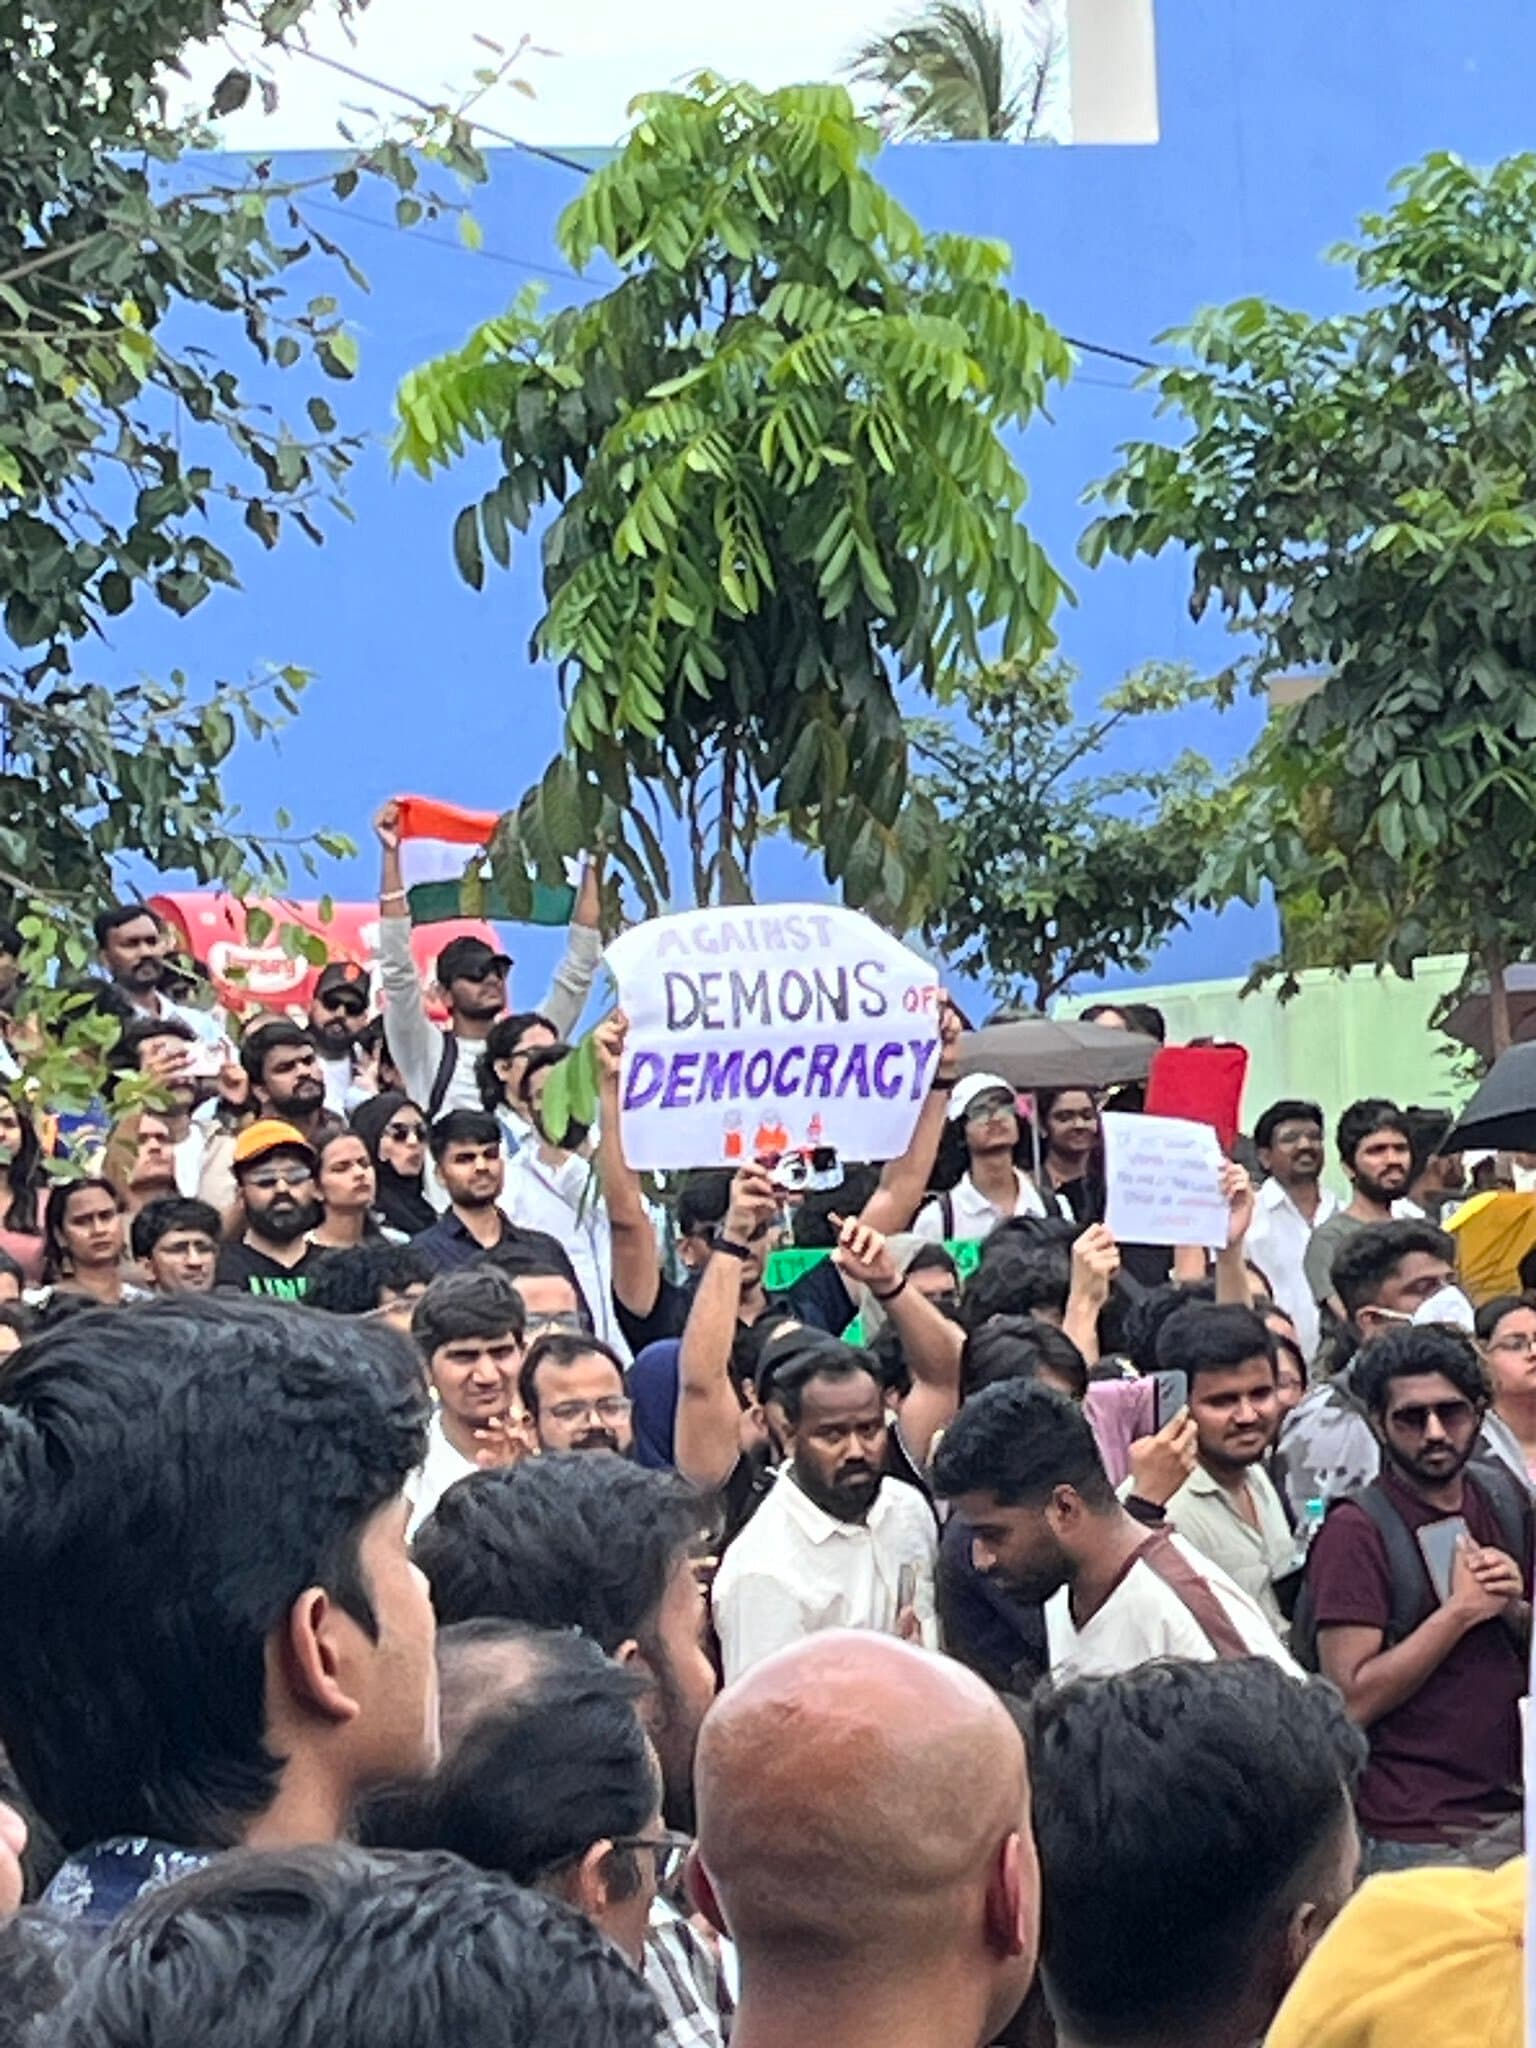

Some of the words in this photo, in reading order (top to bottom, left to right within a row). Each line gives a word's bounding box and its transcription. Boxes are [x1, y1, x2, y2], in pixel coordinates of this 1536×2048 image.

[656, 915, 834, 958] AGAINST
[663, 960, 888, 1031] DEMONS
[902, 985, 937, 1014] OF
[623, 1039, 937, 1112] DEMOCRACY
